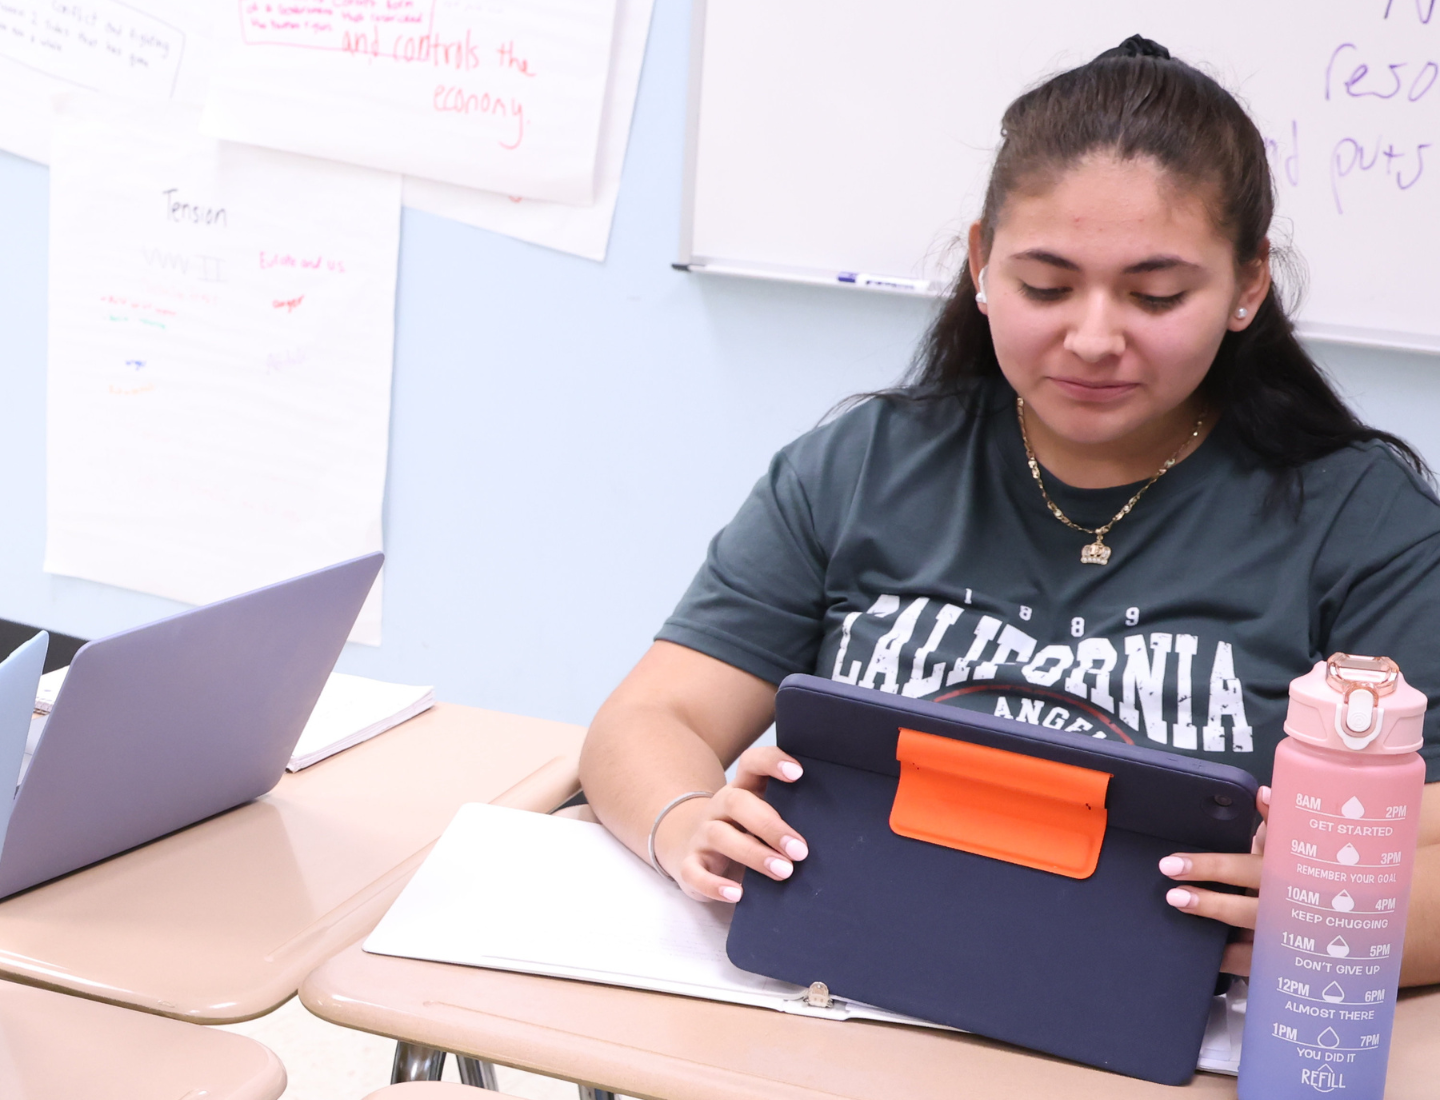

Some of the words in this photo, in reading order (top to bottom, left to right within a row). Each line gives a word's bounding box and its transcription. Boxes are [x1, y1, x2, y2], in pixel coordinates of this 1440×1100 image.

[342, 25, 379, 56] and
[496, 40, 537, 77] the
[1263, 120, 1298, 187] nd
[1329, 137, 1433, 215] puts
[163, 188, 227, 227] Tension
[831, 594, 1254, 752] CALIFORNIA
[1296, 793, 1321, 810] 8AM
[1385, 805, 1407, 818] 2PM
[1309, 819, 1334, 832] GET
[1337, 824, 1393, 836] STARTED
[1291, 840, 1317, 857] 9AM
[1380, 852, 1401, 865] 3PM
[1296, 863, 1347, 882] REMEMBER
[1350, 874, 1375, 884] YOUR
[1378, 873, 1396, 884] GOAL
[1287, 885, 1320, 906] 10AM
[1375, 898, 1396, 911] 4PM
[1291, 908, 1322, 925] KEEP
[1325, 916, 1388, 929] CHUGGING
[1282, 931, 1315, 951] 11AM
[1369, 944, 1390, 957] 5PM
[1295, 957, 1332, 973] DON'T
[1336, 964, 1363, 975] GIVE
[1365, 965, 1380, 975] UP
[1277, 976, 1310, 997] 12PM
[1364, 989, 1385, 1002] 6PM
[1285, 1001, 1336, 1020] ALMOST
[1339, 1010, 1375, 1020] THERE
[1272, 1022, 1298, 1041] 1PM
[1360, 1034, 1380, 1047] 7PM
[1296, 1047, 1321, 1060] YOU
[1324, 1053, 1344, 1062] DID
[1346, 1053, 1356, 1063] IT
[1301, 1068, 1346, 1089] REFILL
